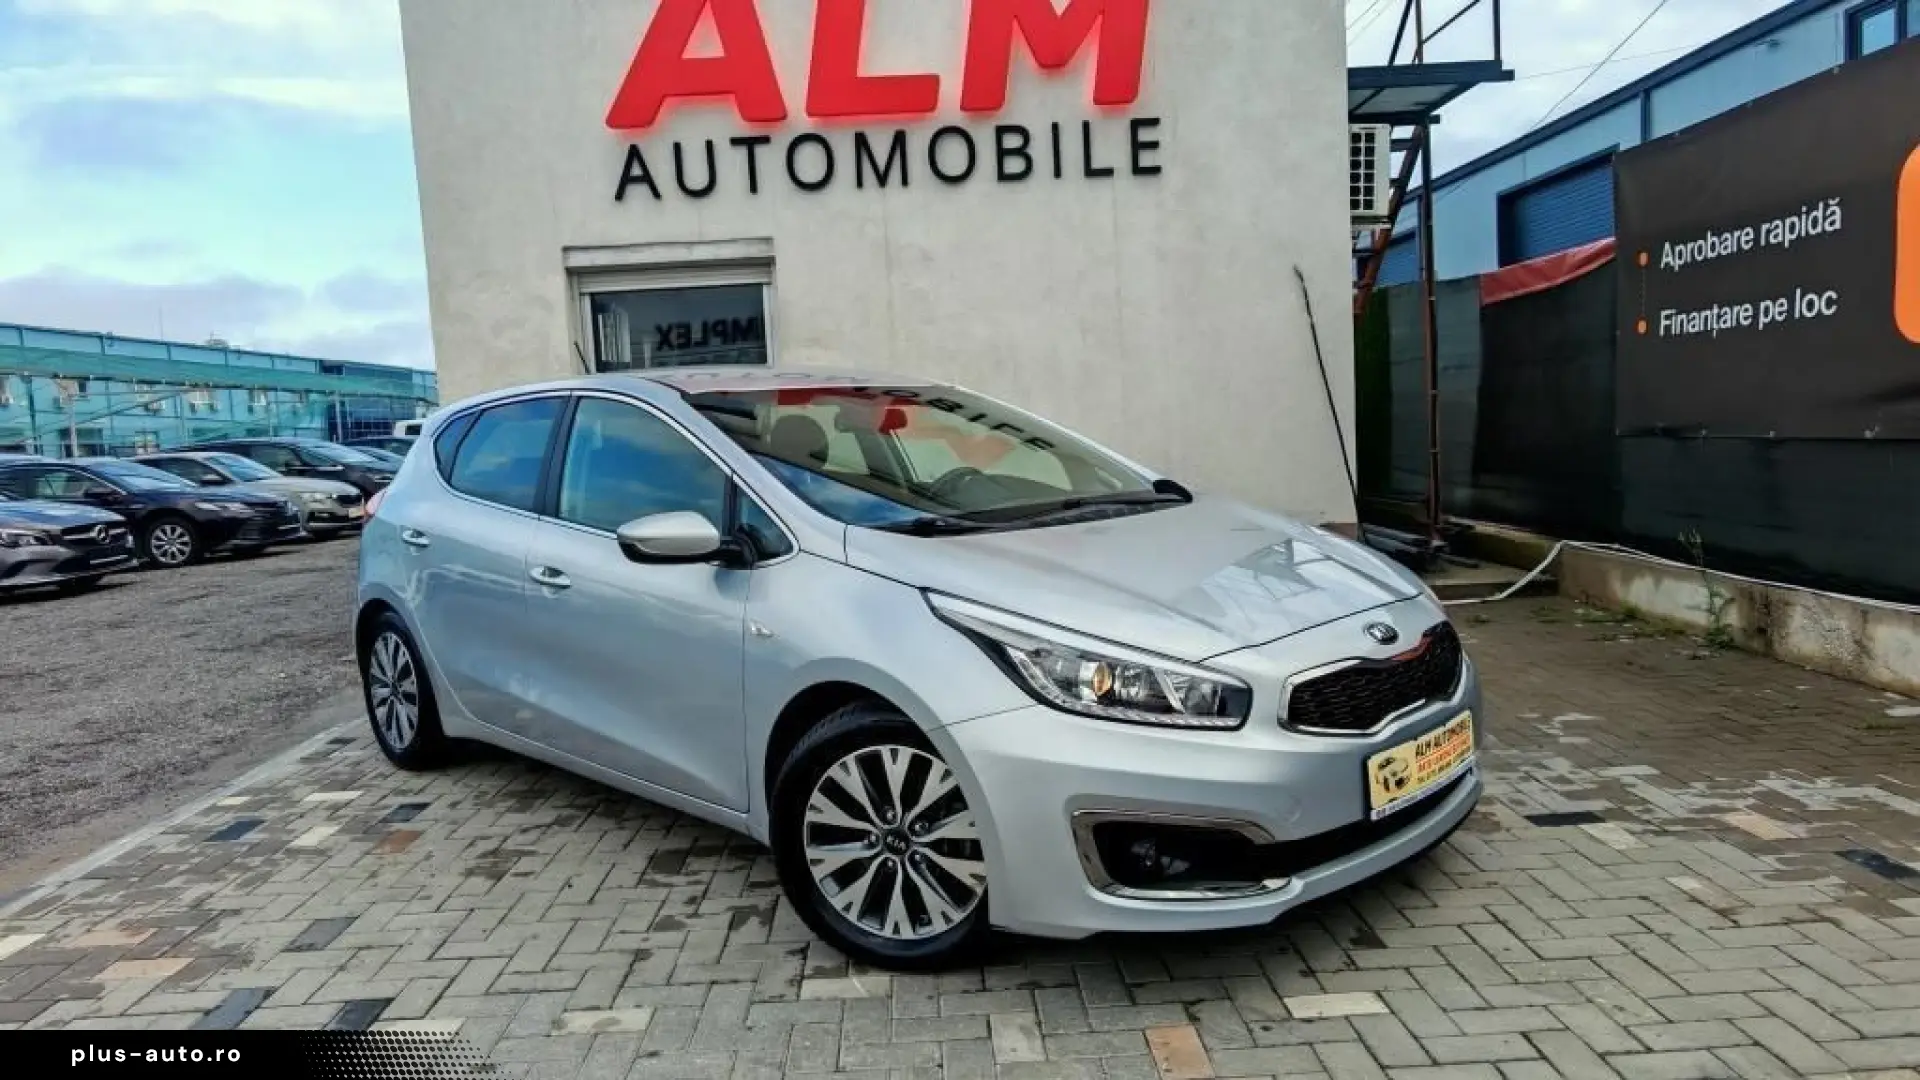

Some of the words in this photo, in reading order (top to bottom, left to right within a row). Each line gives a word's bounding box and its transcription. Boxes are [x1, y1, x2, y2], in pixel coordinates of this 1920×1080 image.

[604, 0, 1150, 129] ALM
[614, 117, 1162, 201] AUTOMOBILE
[1660, 225, 1754, 272] Aprobare
[1760, 196, 1843, 248] rapidă
[1658, 302, 1754, 339] Finanțare
[1758, 296, 1788, 331] pe
[1793, 287, 1838, 320] loc
